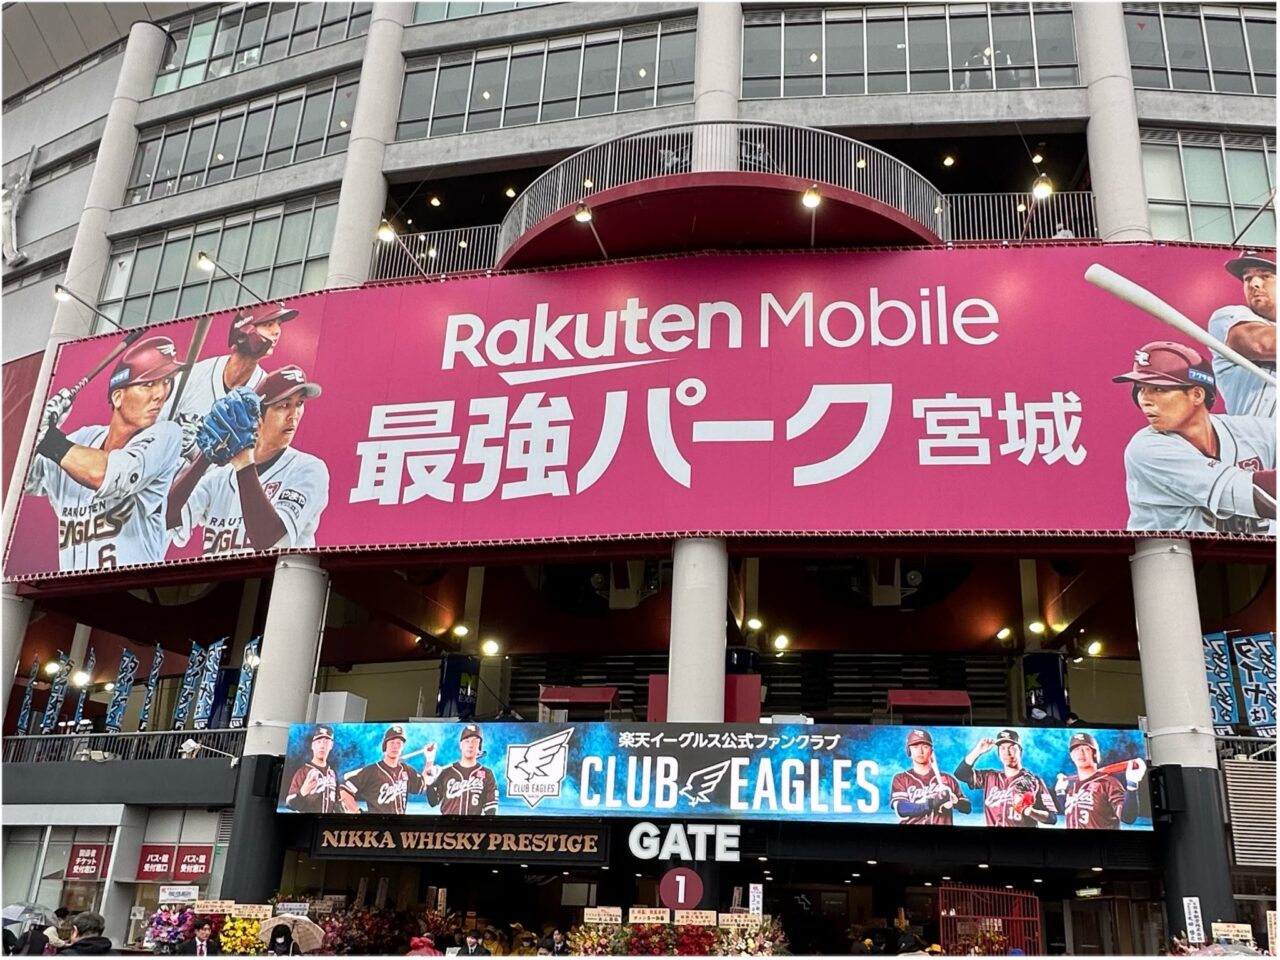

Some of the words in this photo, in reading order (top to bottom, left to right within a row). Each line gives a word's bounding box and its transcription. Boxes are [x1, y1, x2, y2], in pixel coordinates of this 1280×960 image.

[442, 298, 742, 370] Rakuten
[760, 285, 1000, 349] Mobile
[349, 378, 893, 506] 最強パーク
[912, 391, 1087, 467] 宮城
[62, 500, 107, 516] RAKUTEN
[59, 499, 132, 550] EAGLES
[619, 731, 841, 750] 楽天イーグルス公式ファンクラブ
[513, 783, 530, 793] CLUB
[531, 783, 556, 793] EAGLES
[580, 756, 678, 809] CLUB
[729, 757, 881, 813] EAGLES
[471, 794, 480, 806] 6
[1079, 810, 1089, 824] 3
[321, 830, 396, 849] NIKKA
[400, 832, 486, 851] WHISKY
[487, 833, 599, 854] PRESTIGE
[628, 821, 741, 862] GATE
[675, 875, 685, 904] 1
